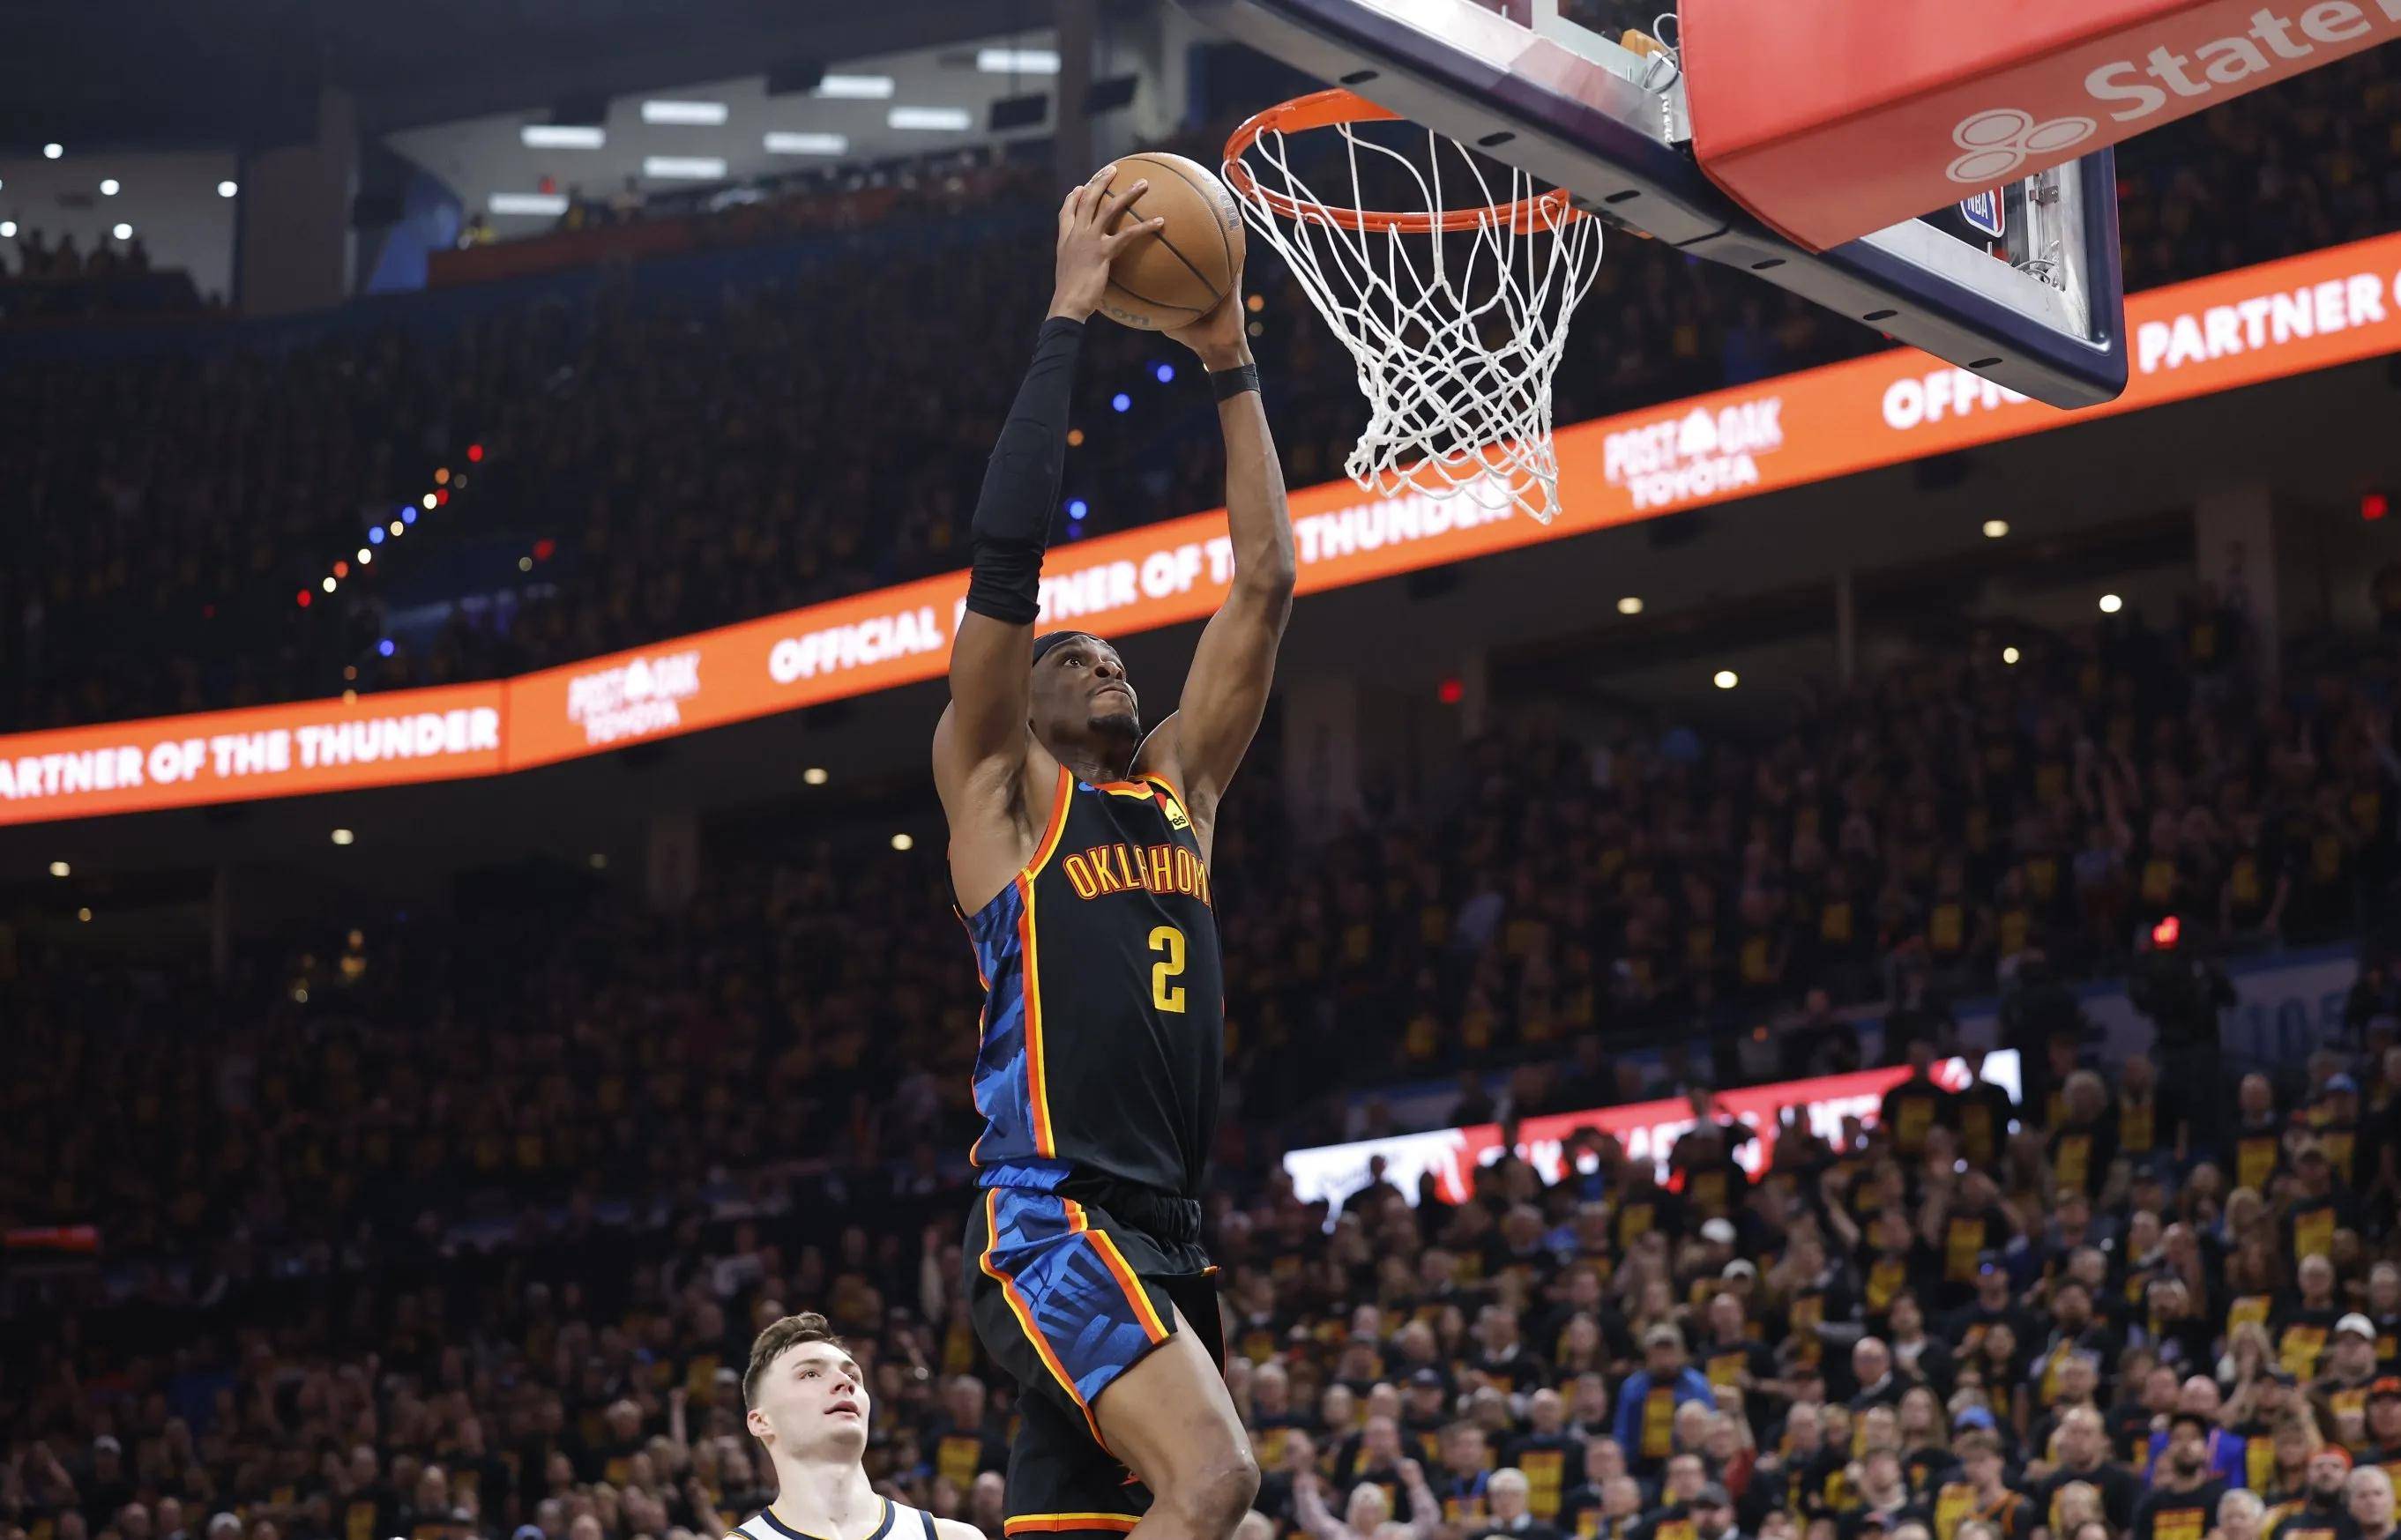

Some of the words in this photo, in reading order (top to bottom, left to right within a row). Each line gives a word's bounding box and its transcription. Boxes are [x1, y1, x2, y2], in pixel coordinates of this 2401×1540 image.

[2084, 0, 2372, 122] State
[1882, 367, 2032, 430] OFFI
[2136, 272, 2386, 374] PARTNER
[1628, 451, 1760, 510] TOYOTA
[768, 606, 944, 684] OFFICIAL
[1140, 543, 1204, 599] OF
[1293, 476, 1516, 564] THUNDER
[148, 740, 206, 784] OF
[210, 729, 292, 777] THE
[295, 708, 500, 767] THUNDER
[1063, 844, 1212, 907] OKLAHOM
[1148, 926, 1185, 1013] 2
